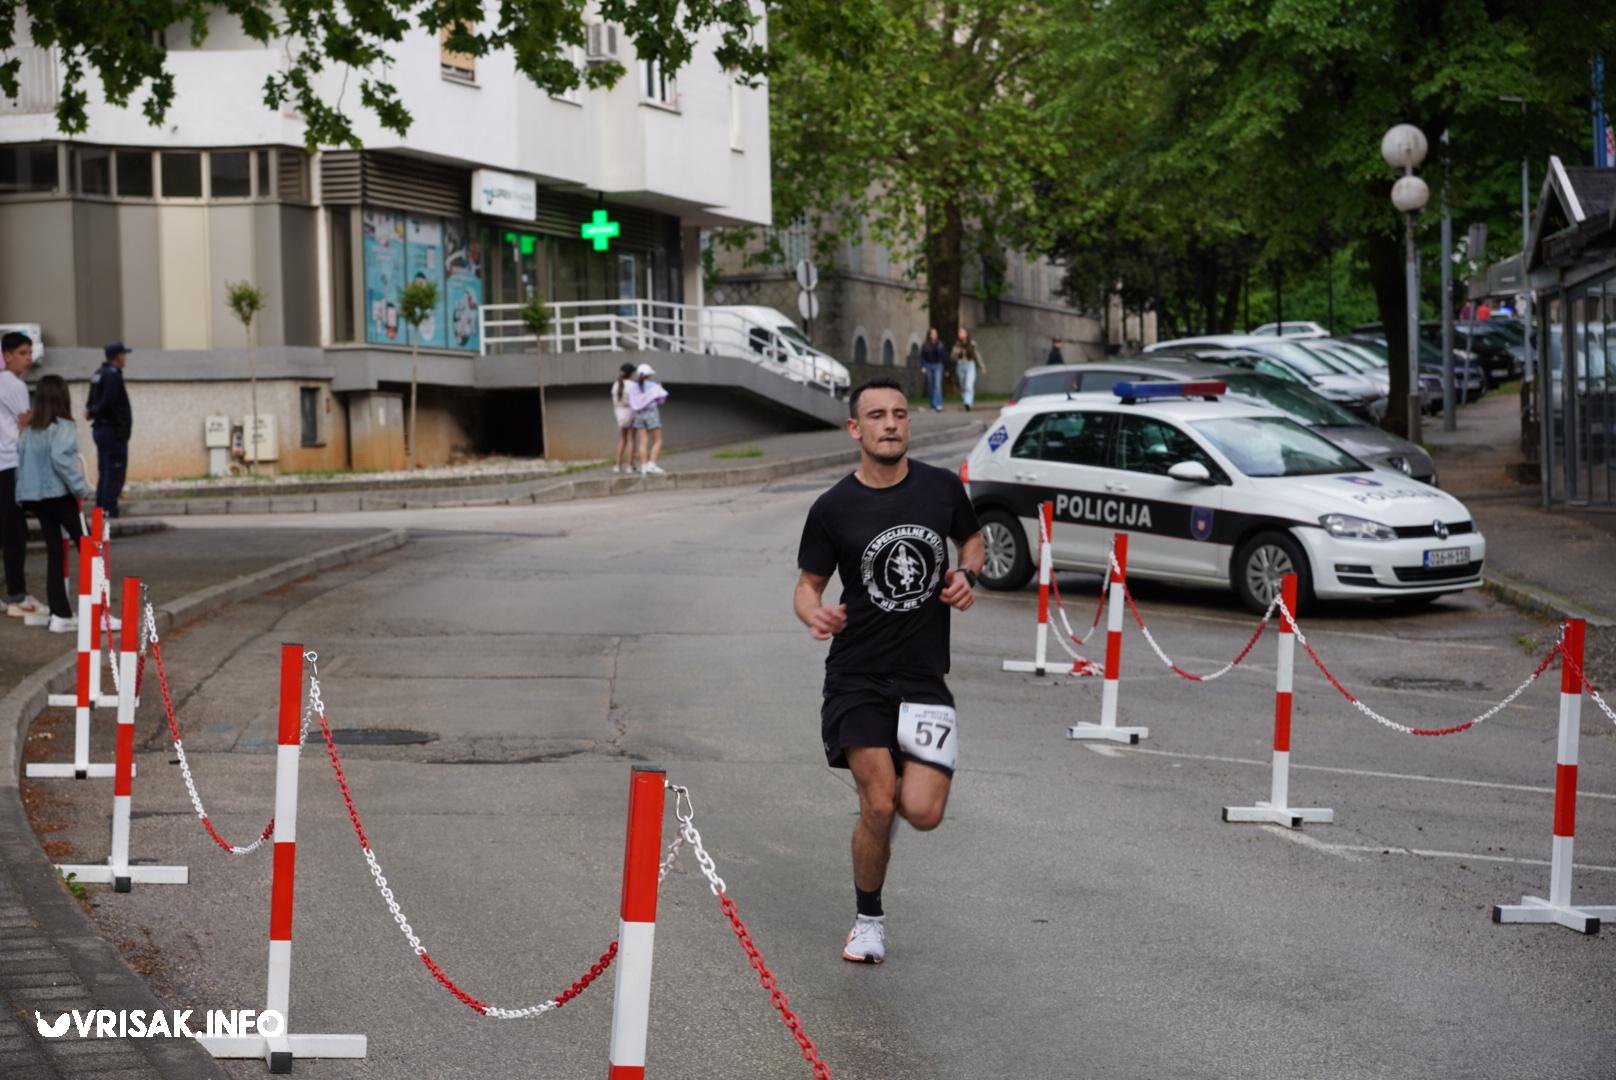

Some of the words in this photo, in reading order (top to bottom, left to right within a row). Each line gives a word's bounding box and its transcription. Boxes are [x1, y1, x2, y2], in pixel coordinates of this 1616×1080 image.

[1055, 494, 1152, 528] POLICIJA
[872, 527, 925, 551] SPECIJALNE
[914, 721, 952, 751] 57
